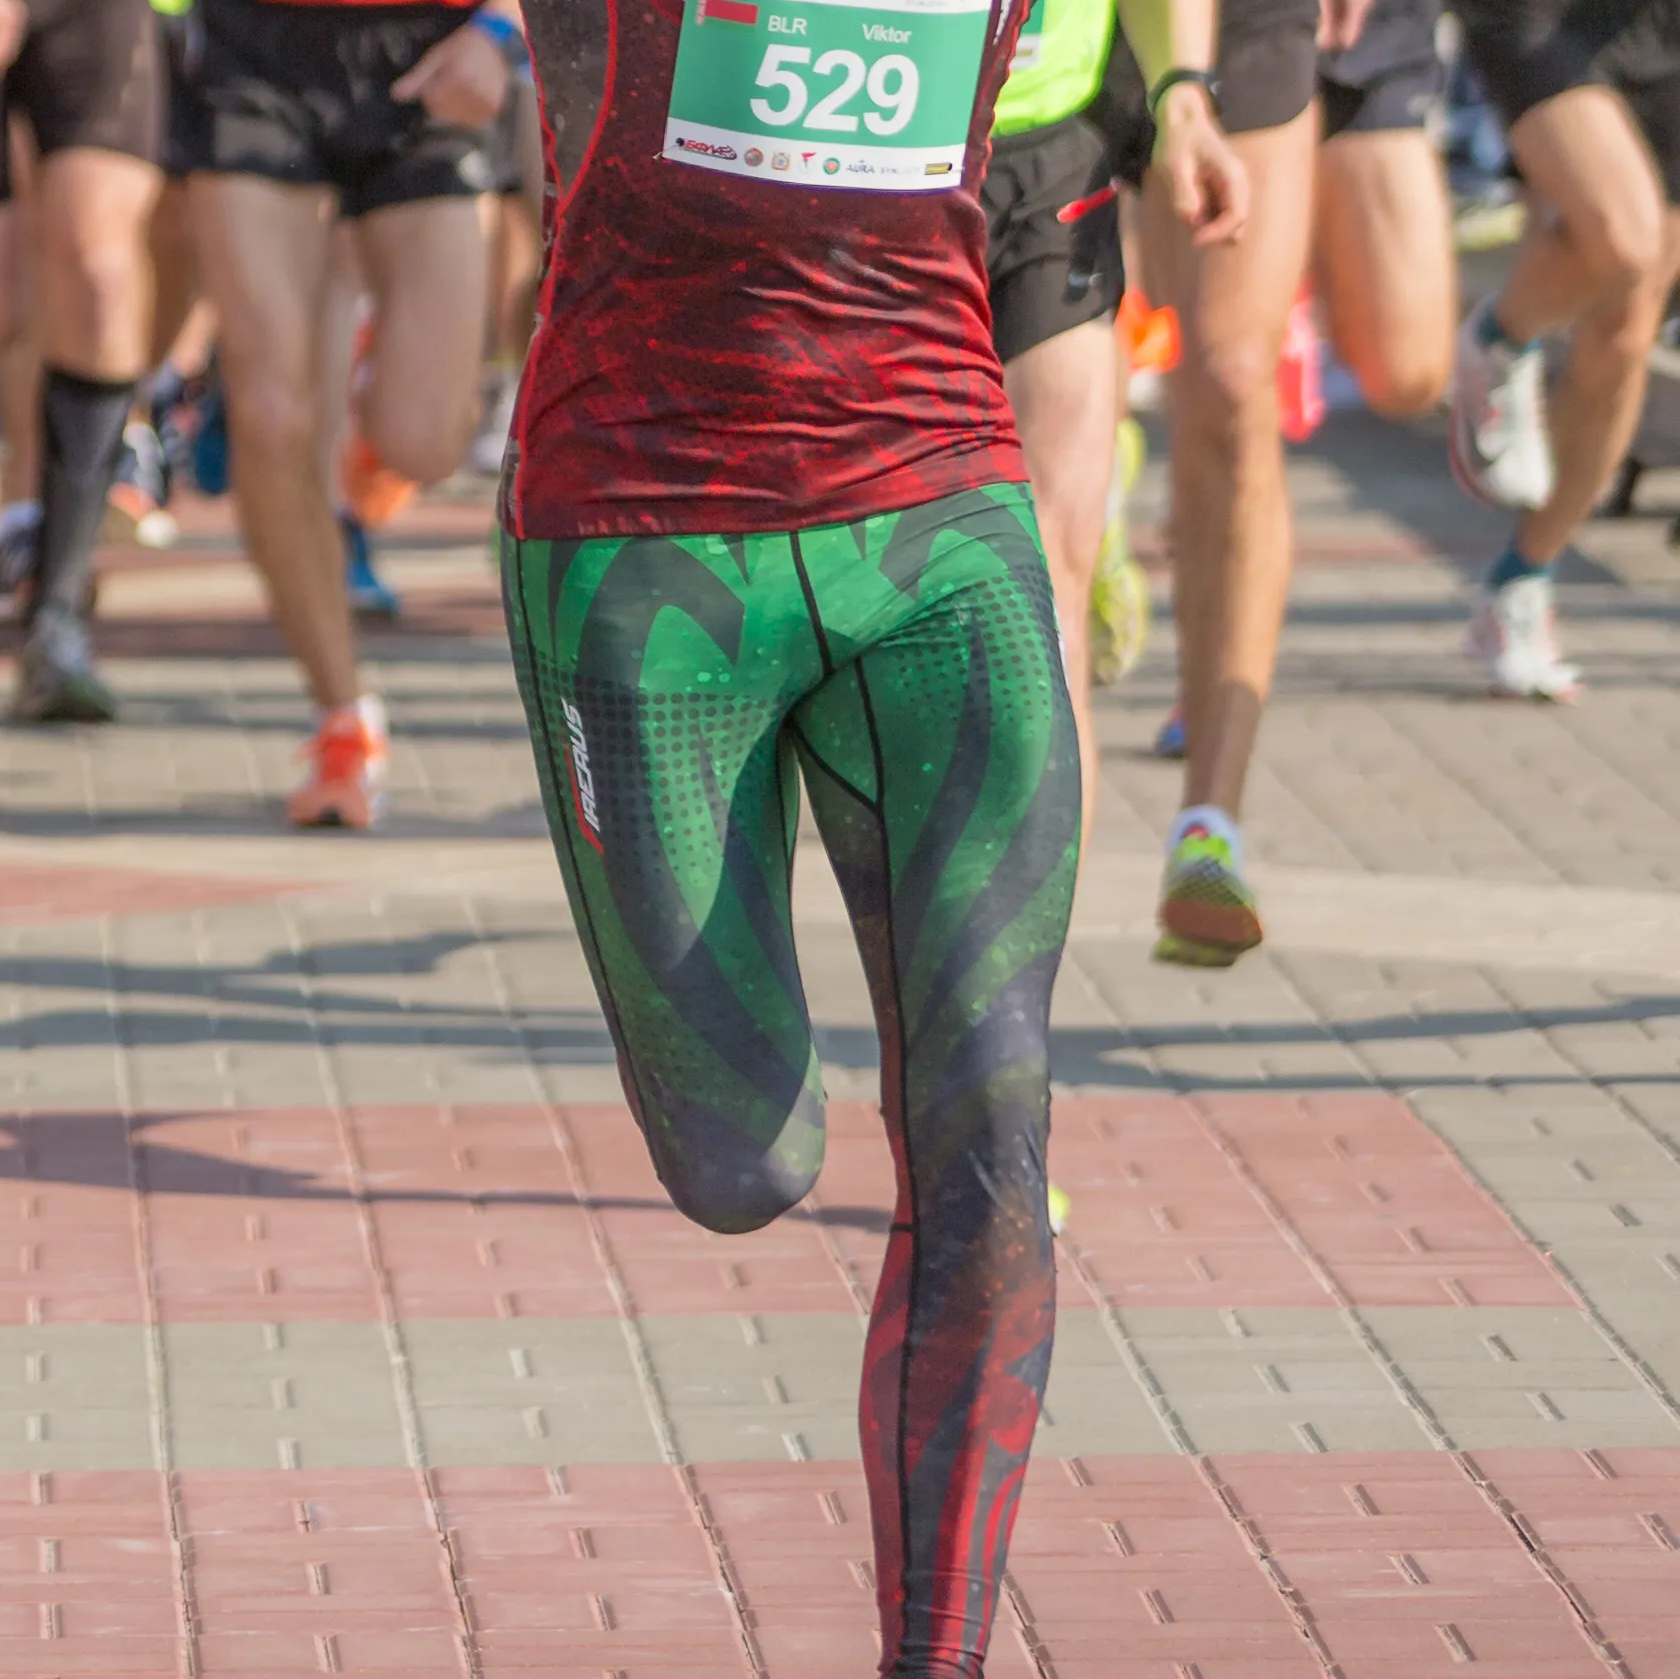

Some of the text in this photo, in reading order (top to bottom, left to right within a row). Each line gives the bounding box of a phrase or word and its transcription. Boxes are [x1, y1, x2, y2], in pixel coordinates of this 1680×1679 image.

[767, 15, 912, 44] BLR Viktor
[749, 43, 920, 136] 529
